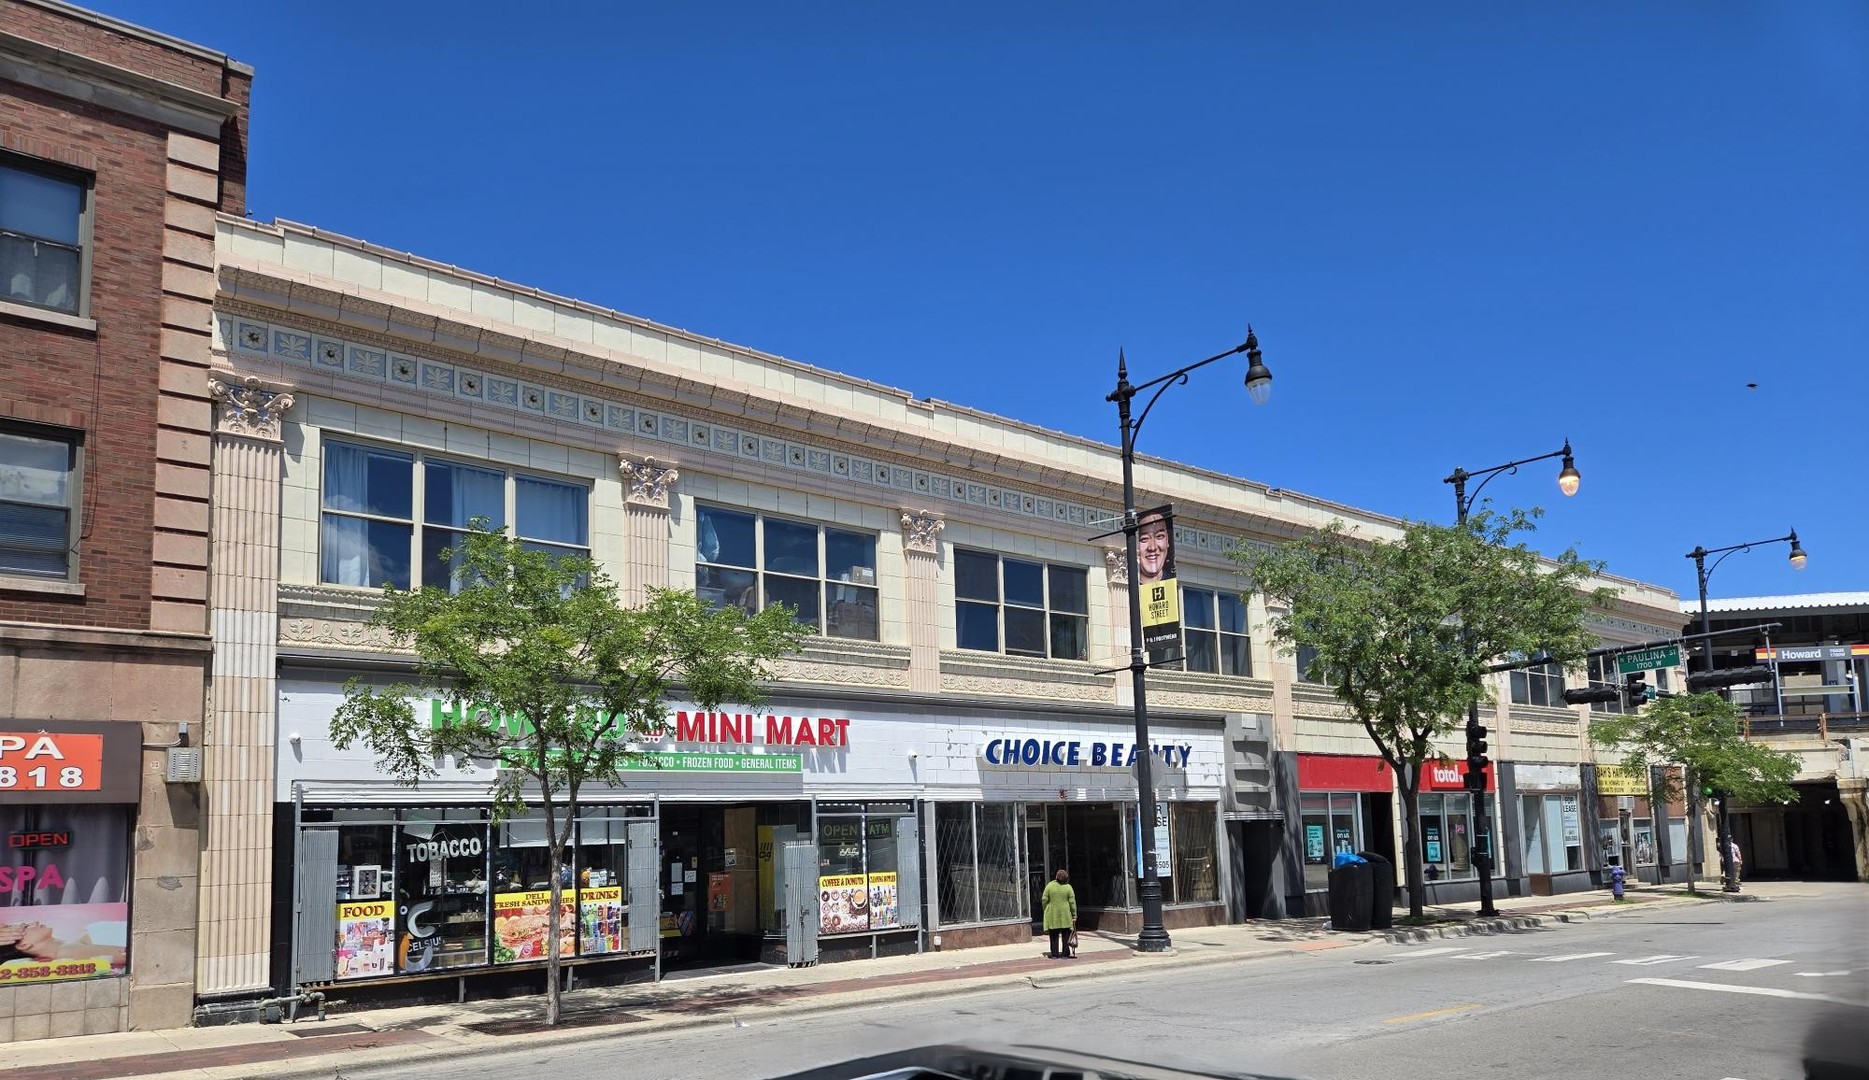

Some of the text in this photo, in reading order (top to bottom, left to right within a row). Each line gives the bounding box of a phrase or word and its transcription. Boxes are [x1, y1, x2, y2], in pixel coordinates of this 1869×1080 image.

[1148, 601, 1169, 611] HOWARD
[1150, 609, 1169, 619] STREET
[1627, 650, 1666, 663] PAULINA
[1781, 649, 1822, 659] Howard
[1636, 661, 1653, 669] 1700
[676, 711, 851, 747] MINI MART
[985, 738, 1081, 766] CHOICE
[682, 756, 712, 768] FROZEN
[714, 757, 734, 769] FOOD
[741, 758, 774, 769] GENERAL
[775, 759, 797, 769] ITEMS
[1563, 804, 1577, 812] LEASE
[823, 825, 858, 837] OPEN
[869, 823, 890, 835] ATM
[9, 832, 68, 847] OPEN
[406, 837, 482, 863] TOBACCO
[0, 864, 65, 894] SPA
[822, 876, 865, 888] COFFEE & DONUTS
[525, 892, 544, 901] DELI
[580, 890, 619, 902] DRINKS
[494, 900, 520, 909] FRESH
[343, 905, 385, 918] FOOD
